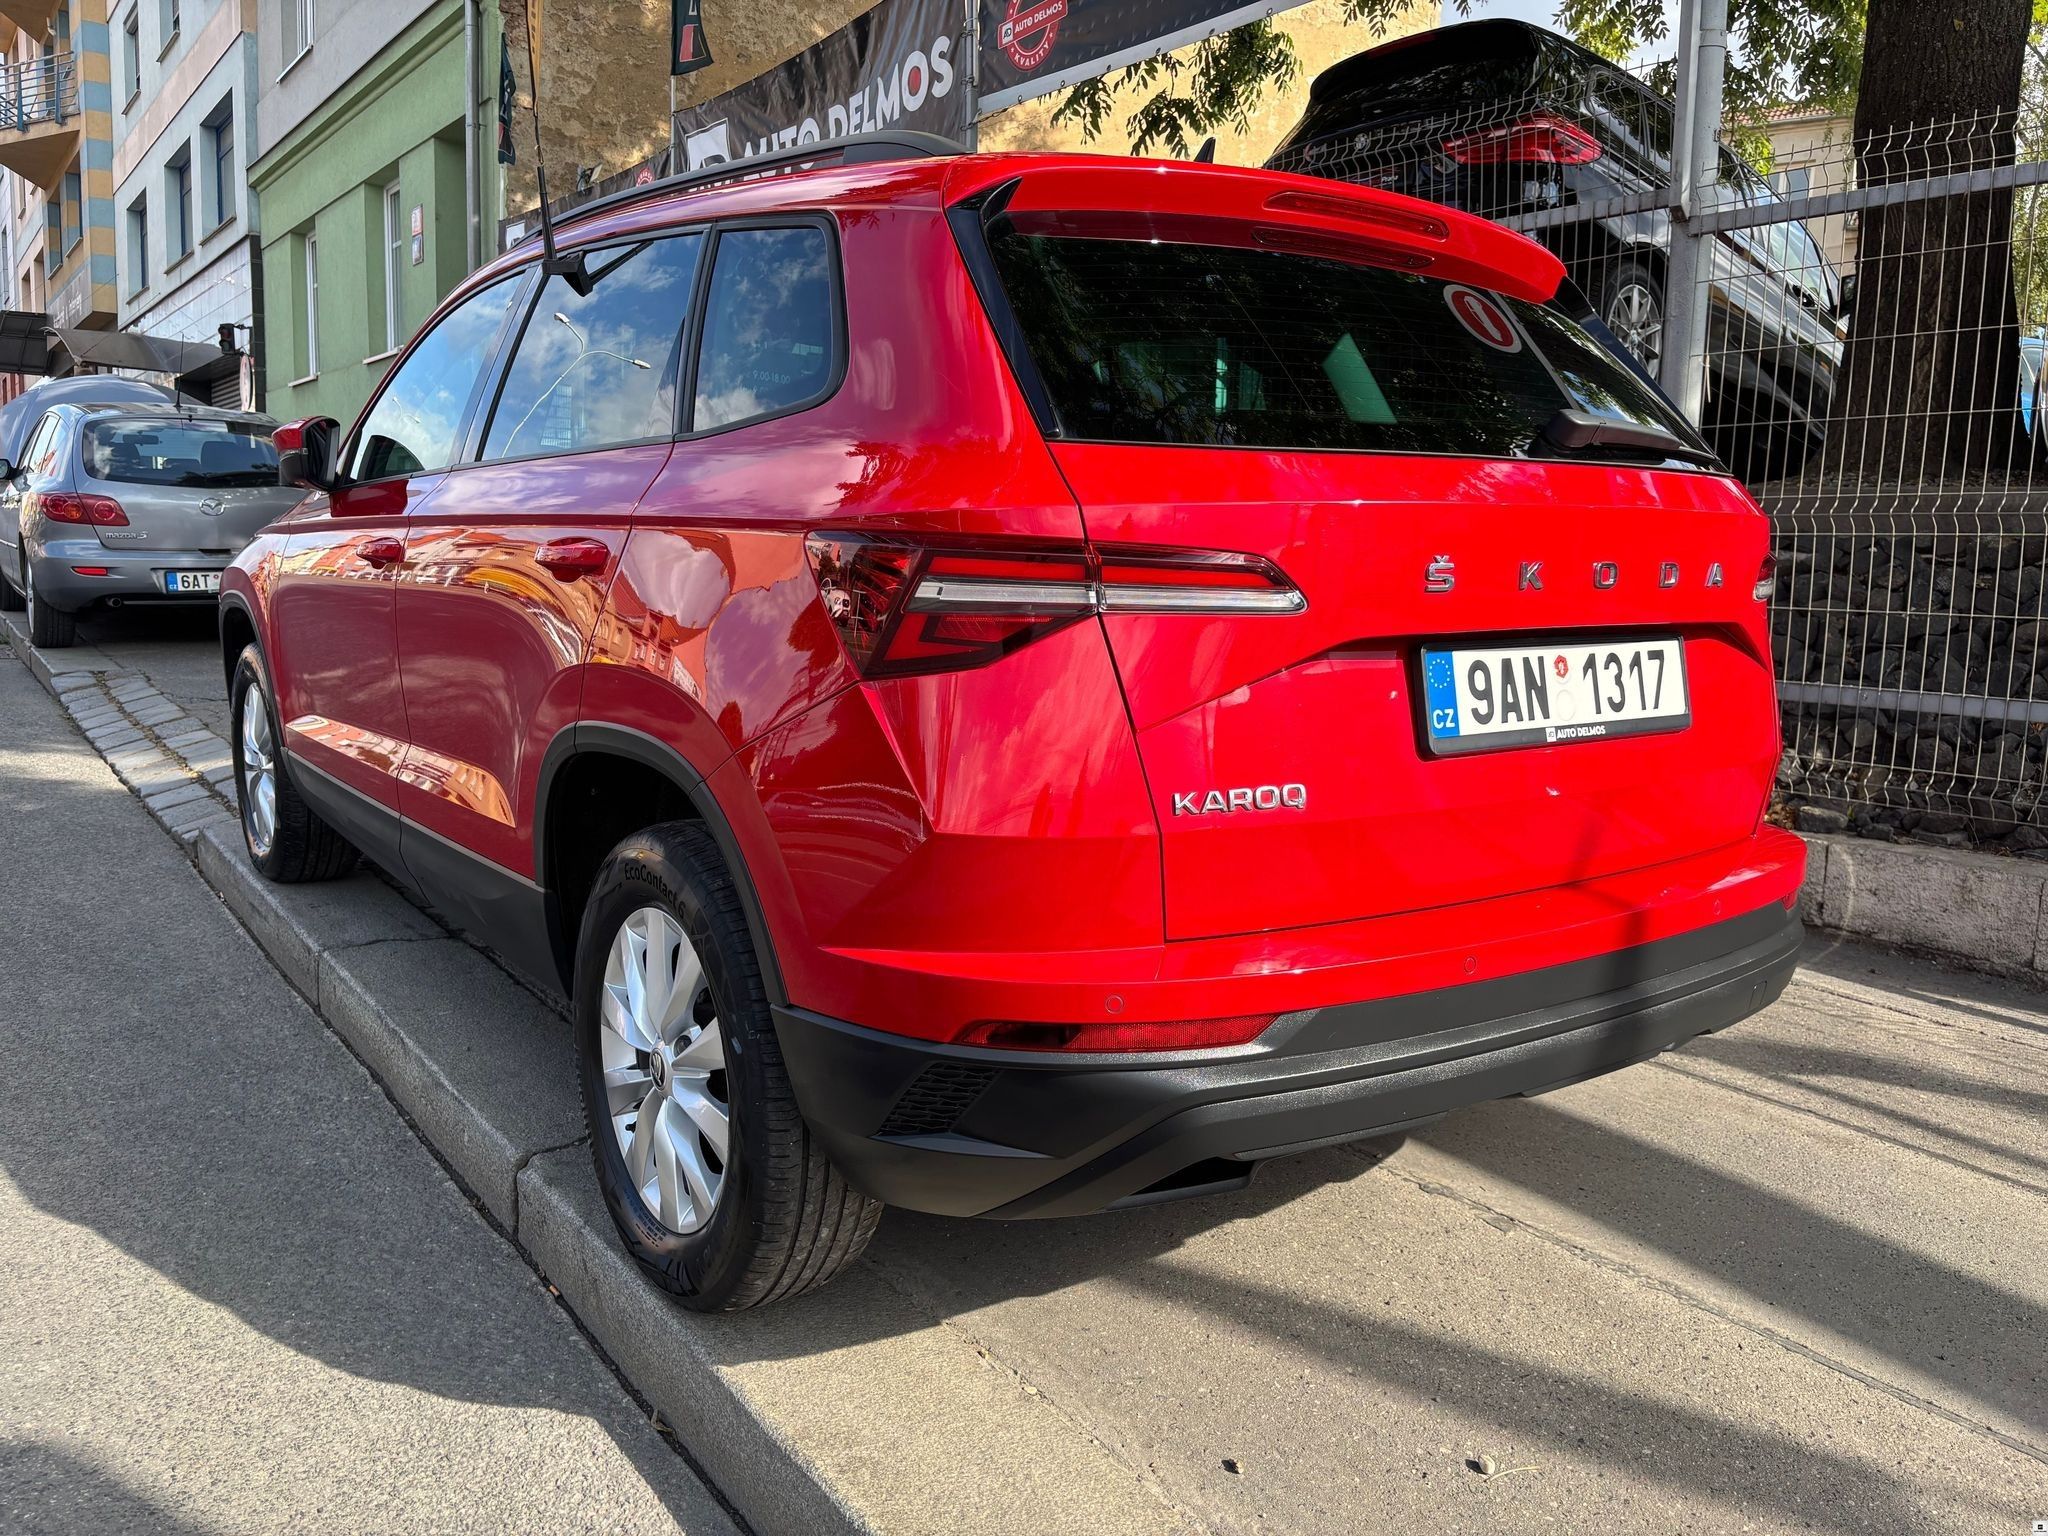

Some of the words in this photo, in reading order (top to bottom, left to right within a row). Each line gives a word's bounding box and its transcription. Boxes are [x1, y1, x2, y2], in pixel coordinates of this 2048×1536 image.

[1014, 17, 1033, 33] AUTO
[1034, 1, 1063, 23] DELMOS
[1014, 42, 1049, 66] KVALITY
[828, 35, 954, 139] DELMOS
[181, 574, 210, 589] 6AT
[1424, 555, 1723, 592] ŠKODA
[1467, 656, 1550, 725] 9AN
[1583, 649, 1664, 714] 1317
[1433, 708, 1455, 729] CZ
[1557, 728, 1577, 738] AUTO
[1577, 725, 1606, 737] DELMOS
[1173, 783, 1306, 816] KAROQ
[624, 862, 678, 911] EcoContact
[678, 901, 687, 919] 6
